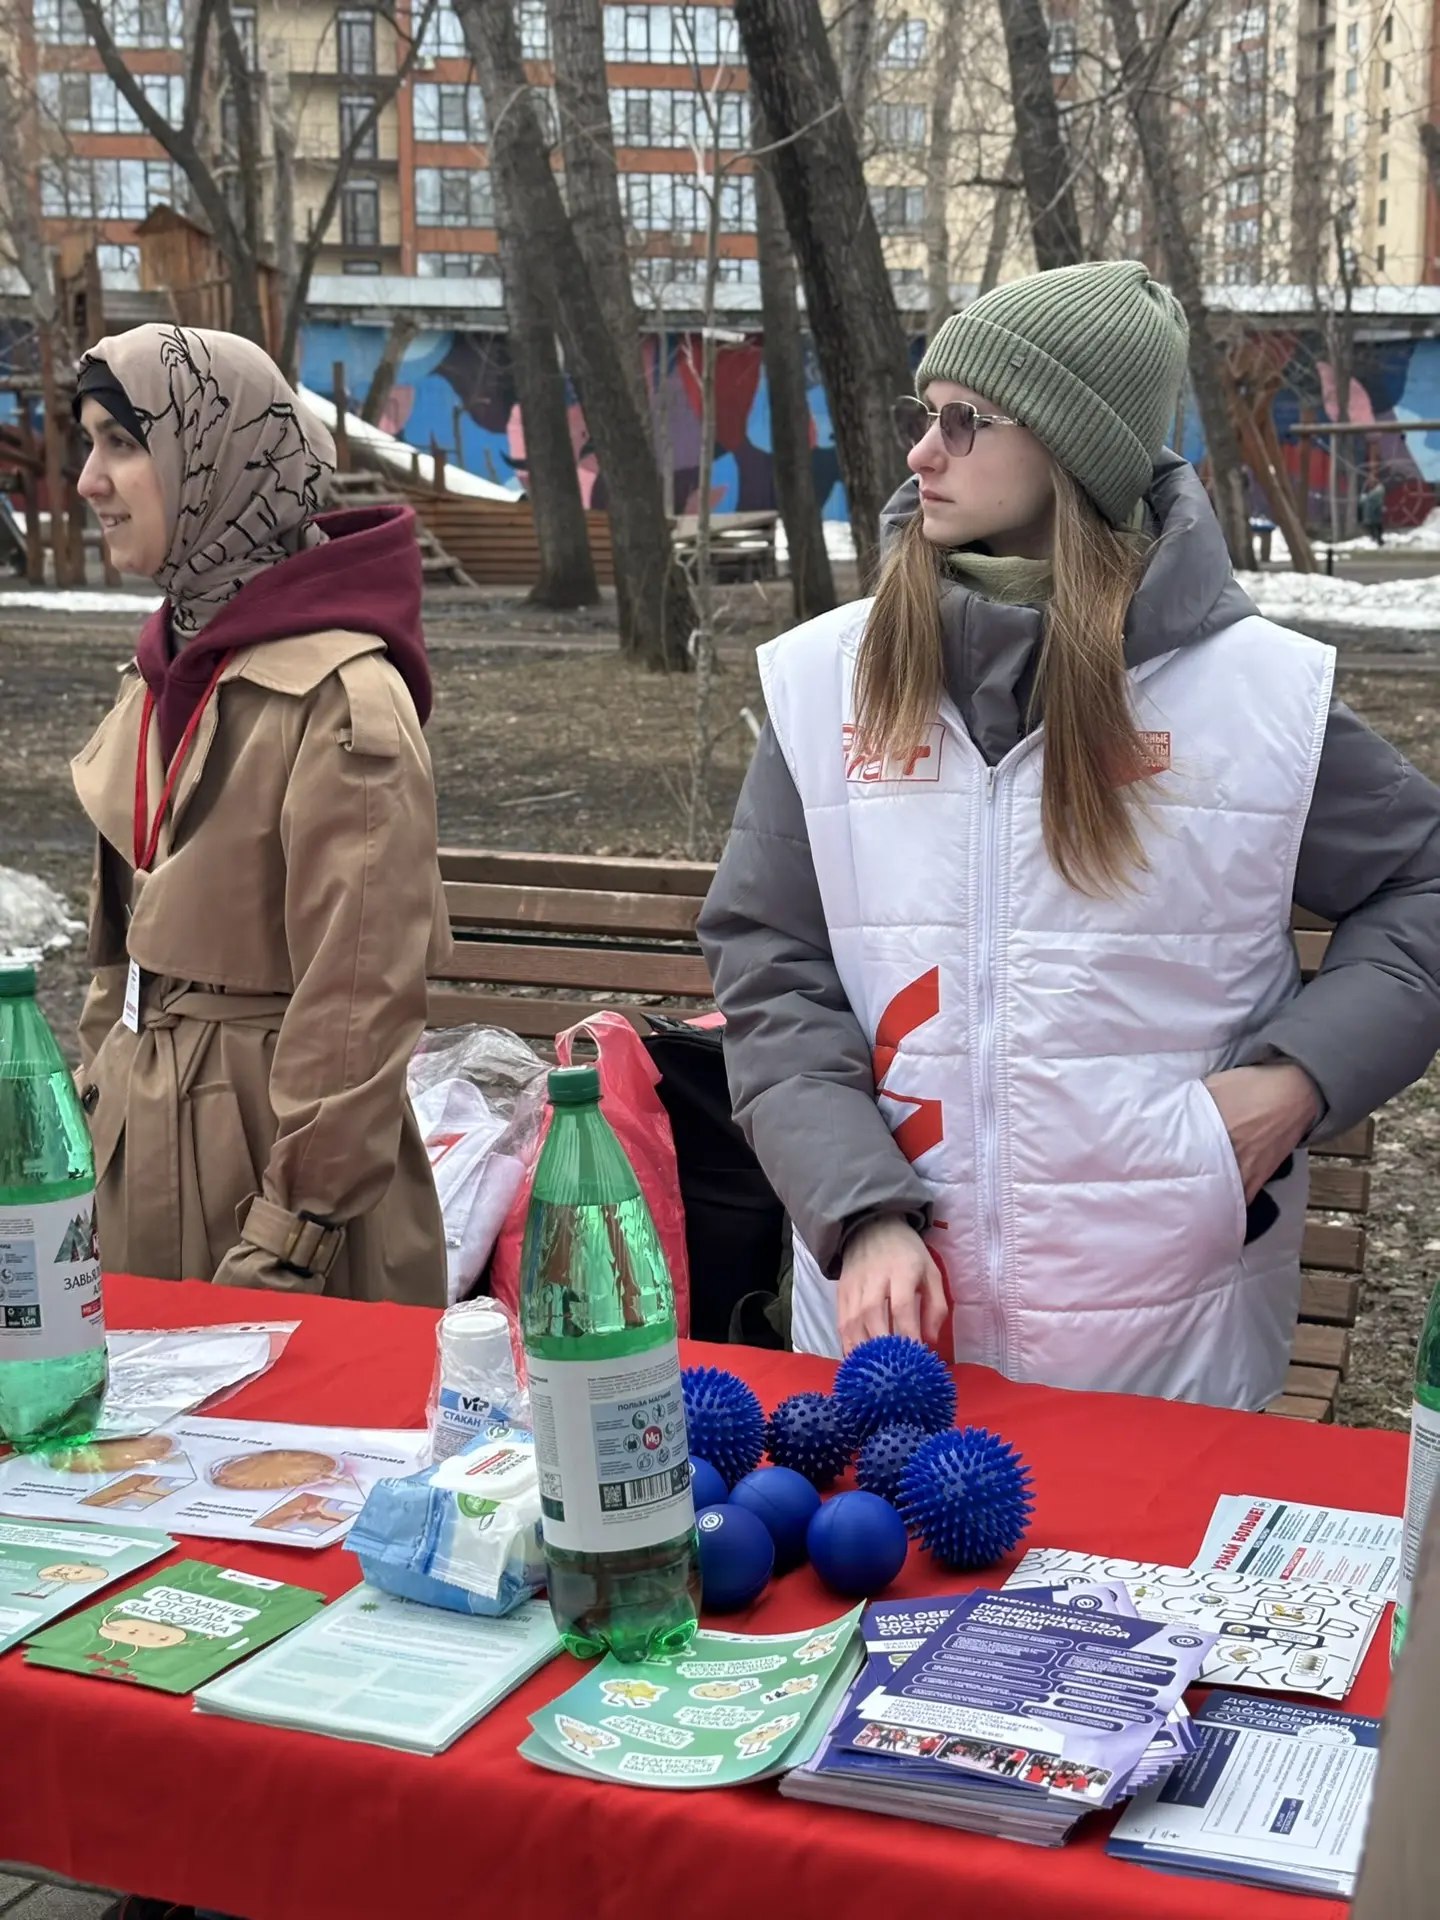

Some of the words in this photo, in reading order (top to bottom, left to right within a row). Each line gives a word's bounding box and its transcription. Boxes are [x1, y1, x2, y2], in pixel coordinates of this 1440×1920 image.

[618, 1399, 647, 1411] ПОЛЬЗА
[443, 1411, 480, 1427] СТАКАН
[645, 1431, 659, 1446] Mg
[1211, 1543, 1243, 1571] УЗНАЙ
[1231, 1507, 1266, 1542] БОЛЬШЕ!
[152, 1589, 251, 1618] ПОСЛАНИЕ
[154, 1600, 181, 1610] ОТ
[183, 1606, 225, 1623] БУДЬ
[125, 1602, 230, 1634] ЗДОРОВИКА
[875, 1613, 911, 1622] КАК
[966, 1614, 1043, 1631] ХОДЬБЫ
[972, 1609, 1131, 1639] СКАНДИНАВСКОЙ
[977, 1603, 1122, 1631] ПРЕИМУЩЕСТВА
[879, 1626, 939, 1636] СУСТА
